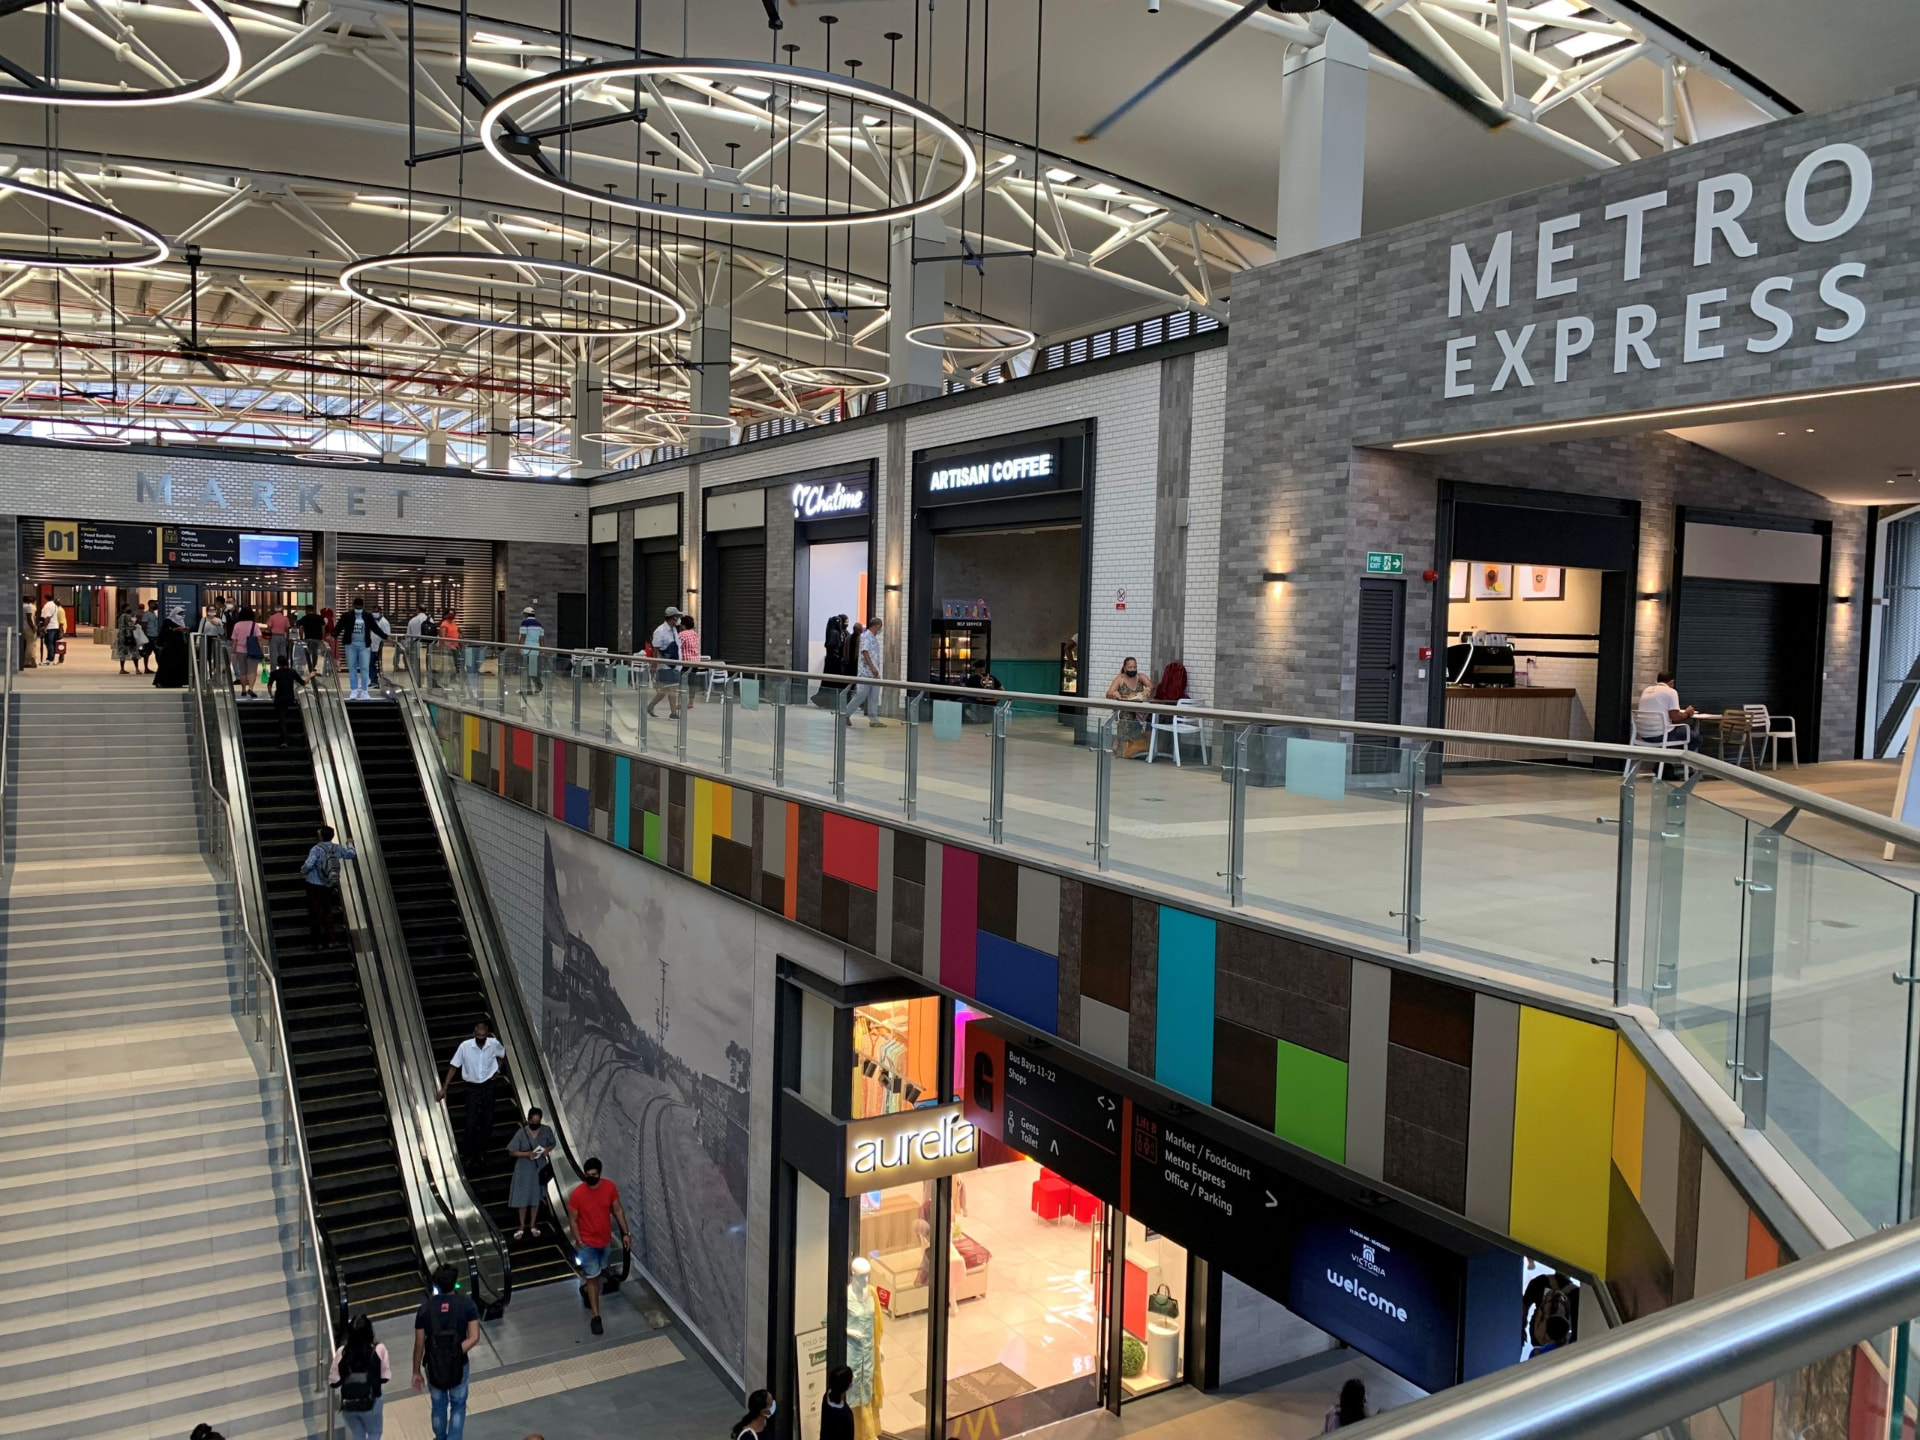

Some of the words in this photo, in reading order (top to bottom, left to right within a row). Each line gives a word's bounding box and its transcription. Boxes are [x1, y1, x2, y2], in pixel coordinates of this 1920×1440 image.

[1448, 143, 1873, 318] METRO
[1444, 262, 1866, 399] EXPRESS
[929, 464, 989, 491] ARTISAN
[992, 454, 1051, 481] COFFEE
[136, 471, 413, 518] MARKET
[804, 483, 864, 517] Chatime
[48, 530, 74, 552] 01
[169, 552, 176, 561] G
[168, 585, 177, 594] 01
[974, 1051, 994, 1112] G
[1008, 1068, 1027, 1086] Shops
[1009, 1050, 1021, 1064] Bus
[1022, 1056, 1036, 1073] Bays
[1037, 1064, 1056, 1083] 11-22
[1020, 1117, 1040, 1136] Gents
[1020, 1130, 1038, 1149] Toilet
[1136, 1115, 1150, 1130] Lift
[1152, 1122, 1157, 1134] B
[854, 1113, 975, 1174] aurelia
[1165, 1130, 1196, 1154] Market
[1205, 1148, 1251, 1180] Foodcourt
[1165, 1150, 1190, 1170] Metro
[1192, 1162, 1226, 1188] Express
[1164, 1170, 1189, 1190] Office
[1198, 1186, 1233, 1216] Parking
[1351, 1253, 1386, 1278] VICTORIA
[1327, 1268, 1408, 1322] welcome
